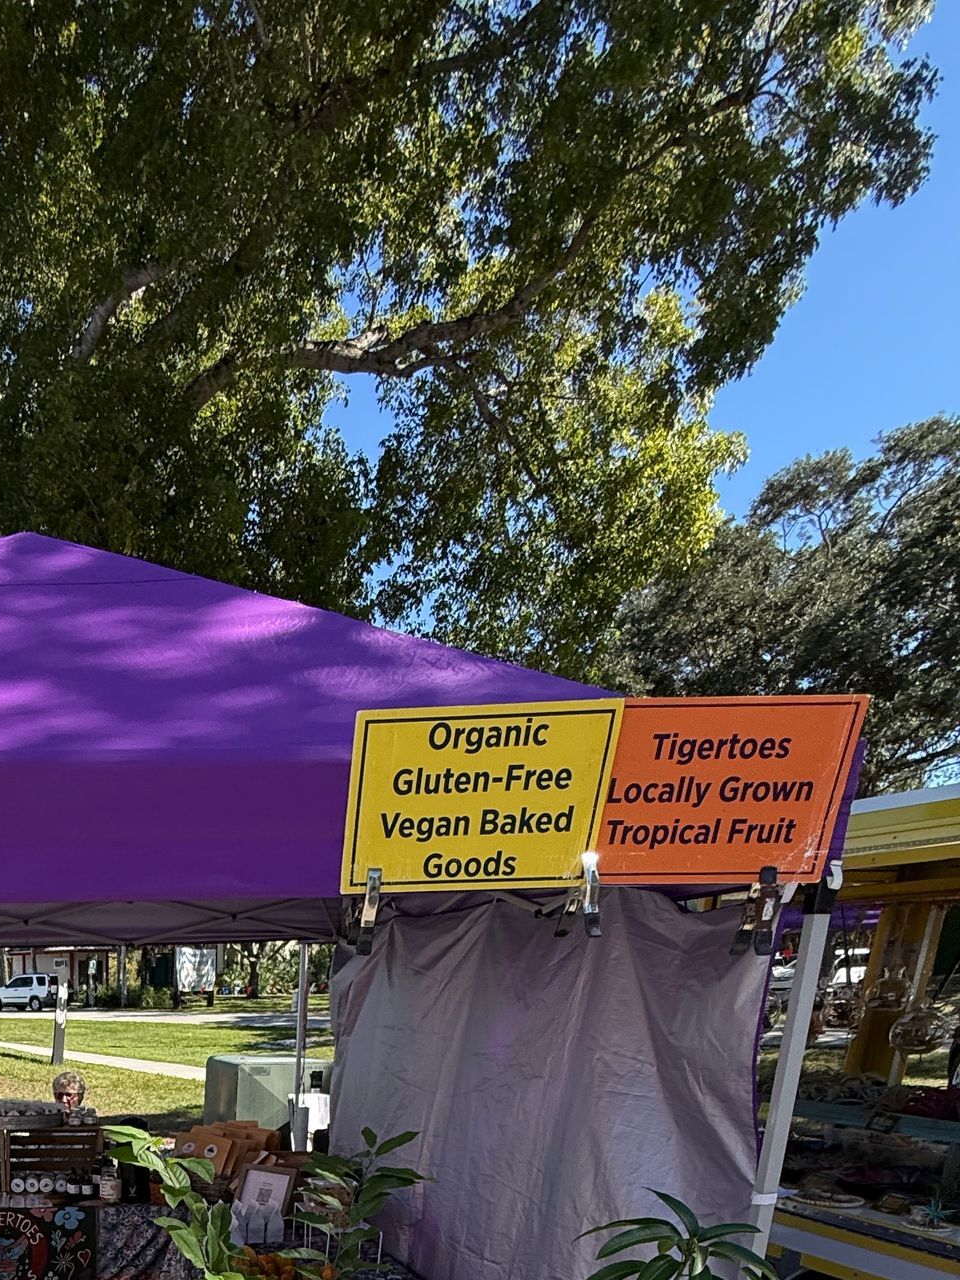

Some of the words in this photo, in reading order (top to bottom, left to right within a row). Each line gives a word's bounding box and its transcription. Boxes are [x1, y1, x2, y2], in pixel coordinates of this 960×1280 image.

[429, 718, 550, 754] Organic
[653, 732, 792, 765] Tigertoes
[392, 764, 573, 796] Gluten-Free
[607, 776, 713, 808] Locally
[719, 776, 814, 804] Grown
[381, 812, 470, 842] Vegan
[479, 805, 575, 835] Baked
[607, 818, 722, 850] Tropical
[727, 818, 797, 844] Fruit
[423, 851, 517, 878] Goods
